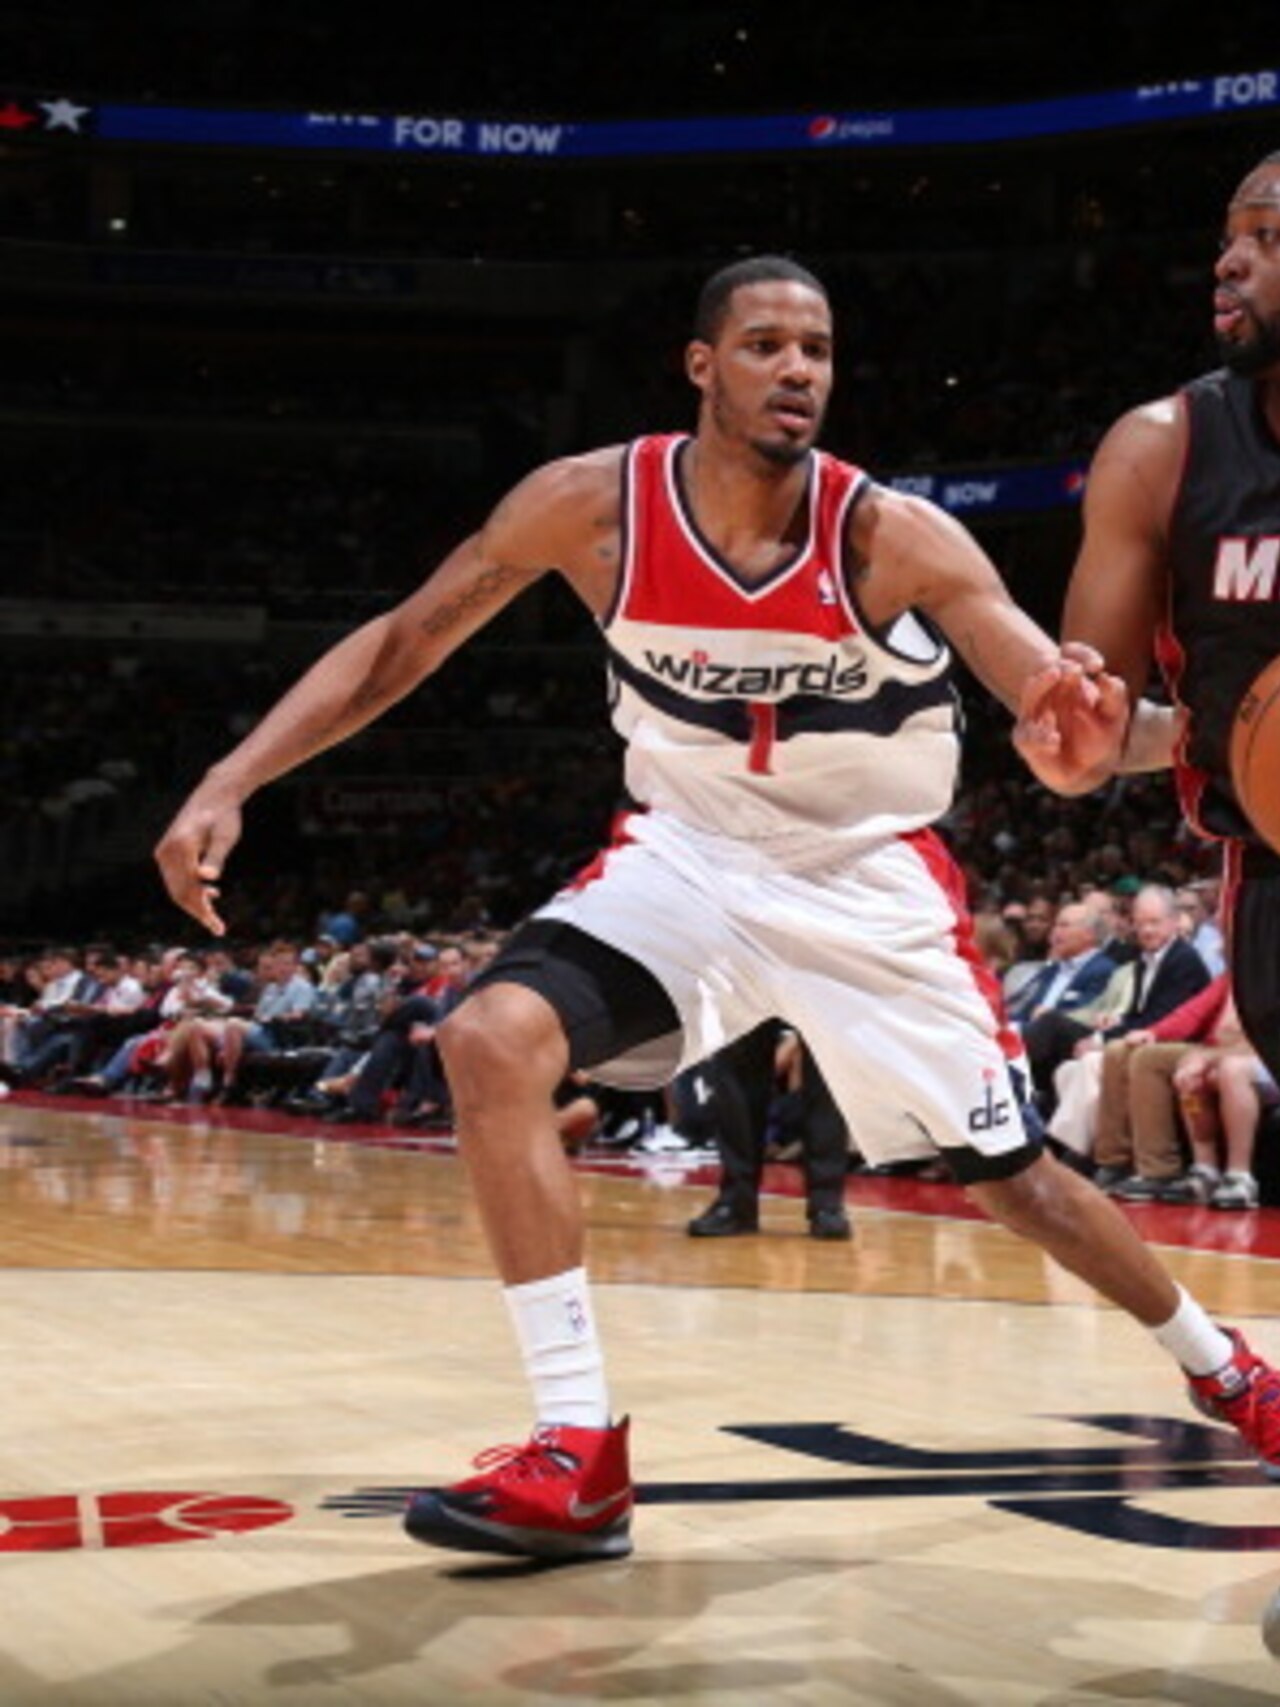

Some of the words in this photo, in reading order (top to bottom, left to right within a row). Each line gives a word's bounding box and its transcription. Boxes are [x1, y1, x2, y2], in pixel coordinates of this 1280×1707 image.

[1213, 71, 1278, 108] FOR
[394, 116, 463, 147] FOR
[479, 121, 561, 153] NOW
[644, 649, 868, 695] wizards
[747, 700, 776, 775] 1
